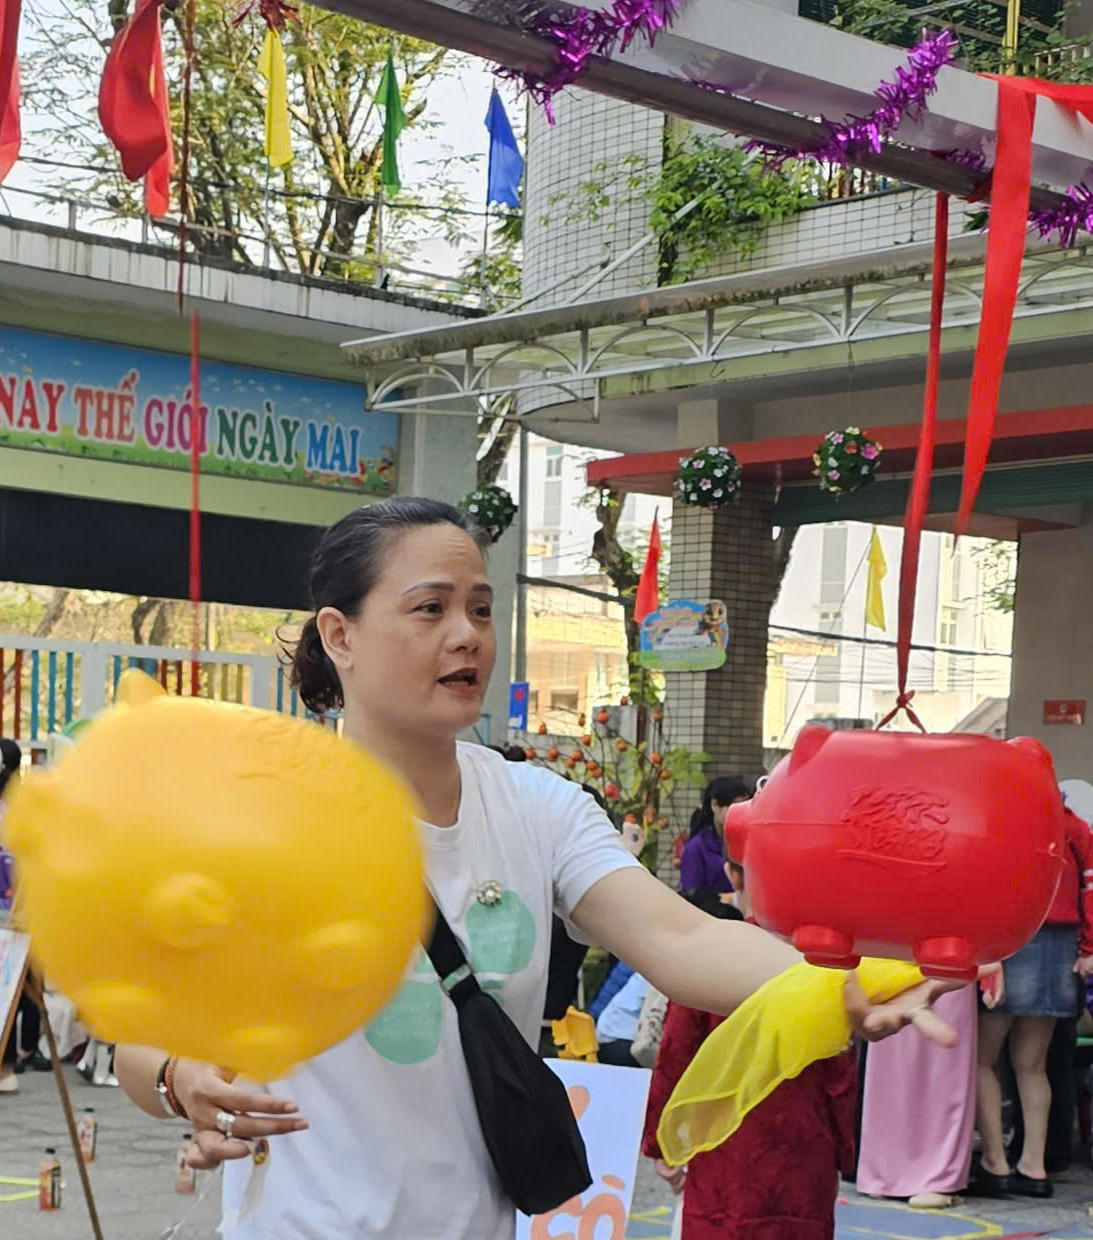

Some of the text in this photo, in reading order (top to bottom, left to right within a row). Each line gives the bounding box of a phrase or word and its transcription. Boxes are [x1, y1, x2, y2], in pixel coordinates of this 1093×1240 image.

[74, 372, 136, 443] THẾ
[217, 401, 300, 465] NGÀY
[307, 422, 360, 474] MAI
